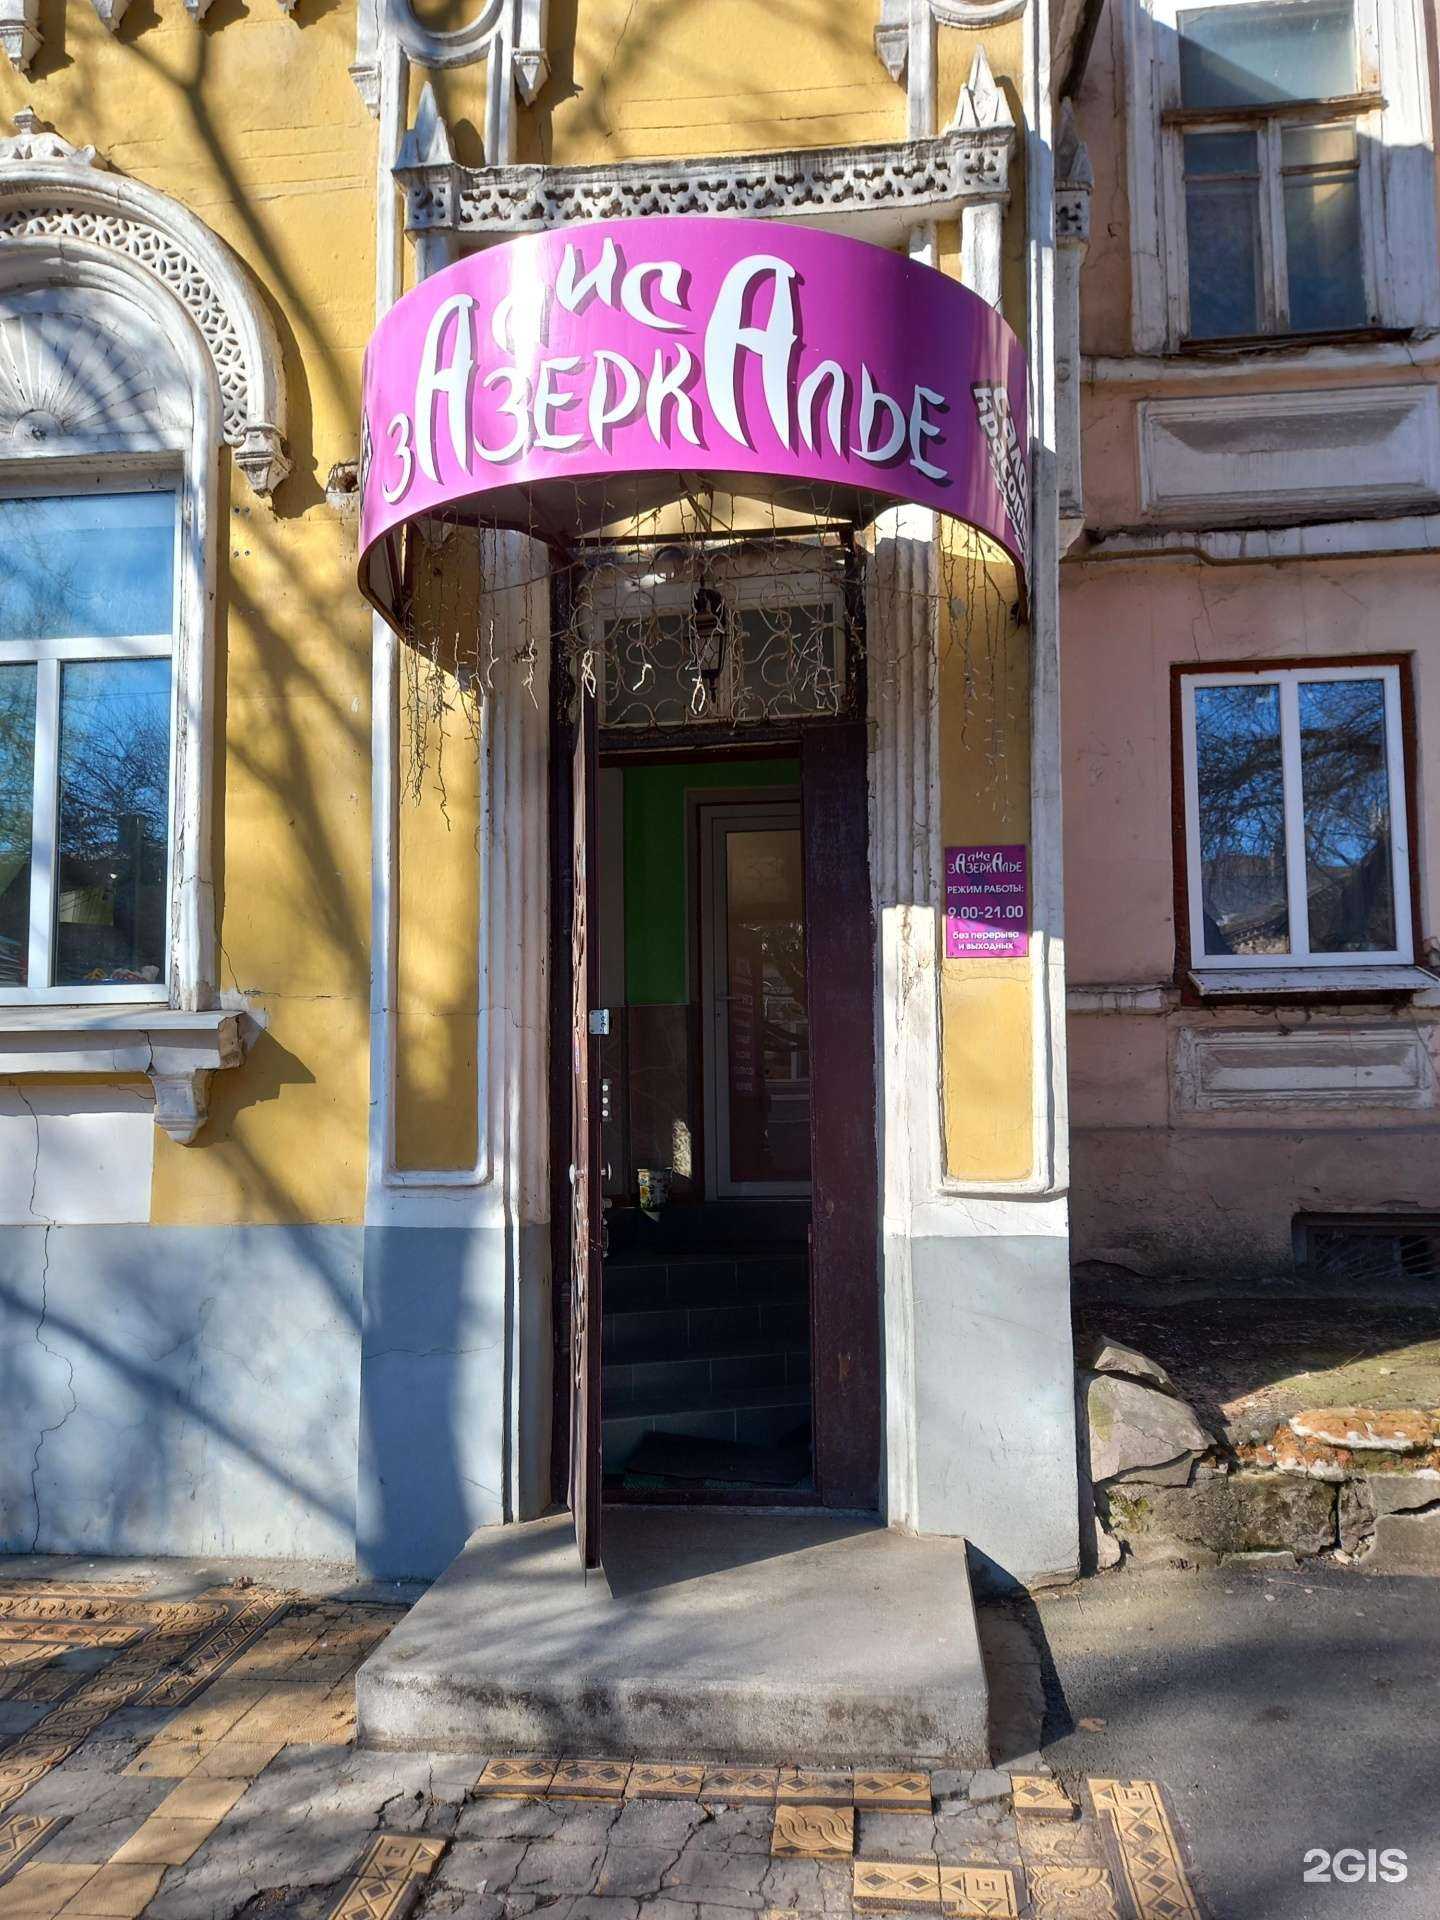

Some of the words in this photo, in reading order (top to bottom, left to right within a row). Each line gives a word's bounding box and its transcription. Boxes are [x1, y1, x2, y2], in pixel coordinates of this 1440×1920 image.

[947, 885, 982, 895] РЕЖИМ
[984, 884, 1024, 894] РАБОТЫ:
[947, 905, 1024, 920] 9.00-21.00
[952, 931, 969, 940] без
[971, 930, 1019, 942] перерыва
[966, 942, 1014, 951] выходных
